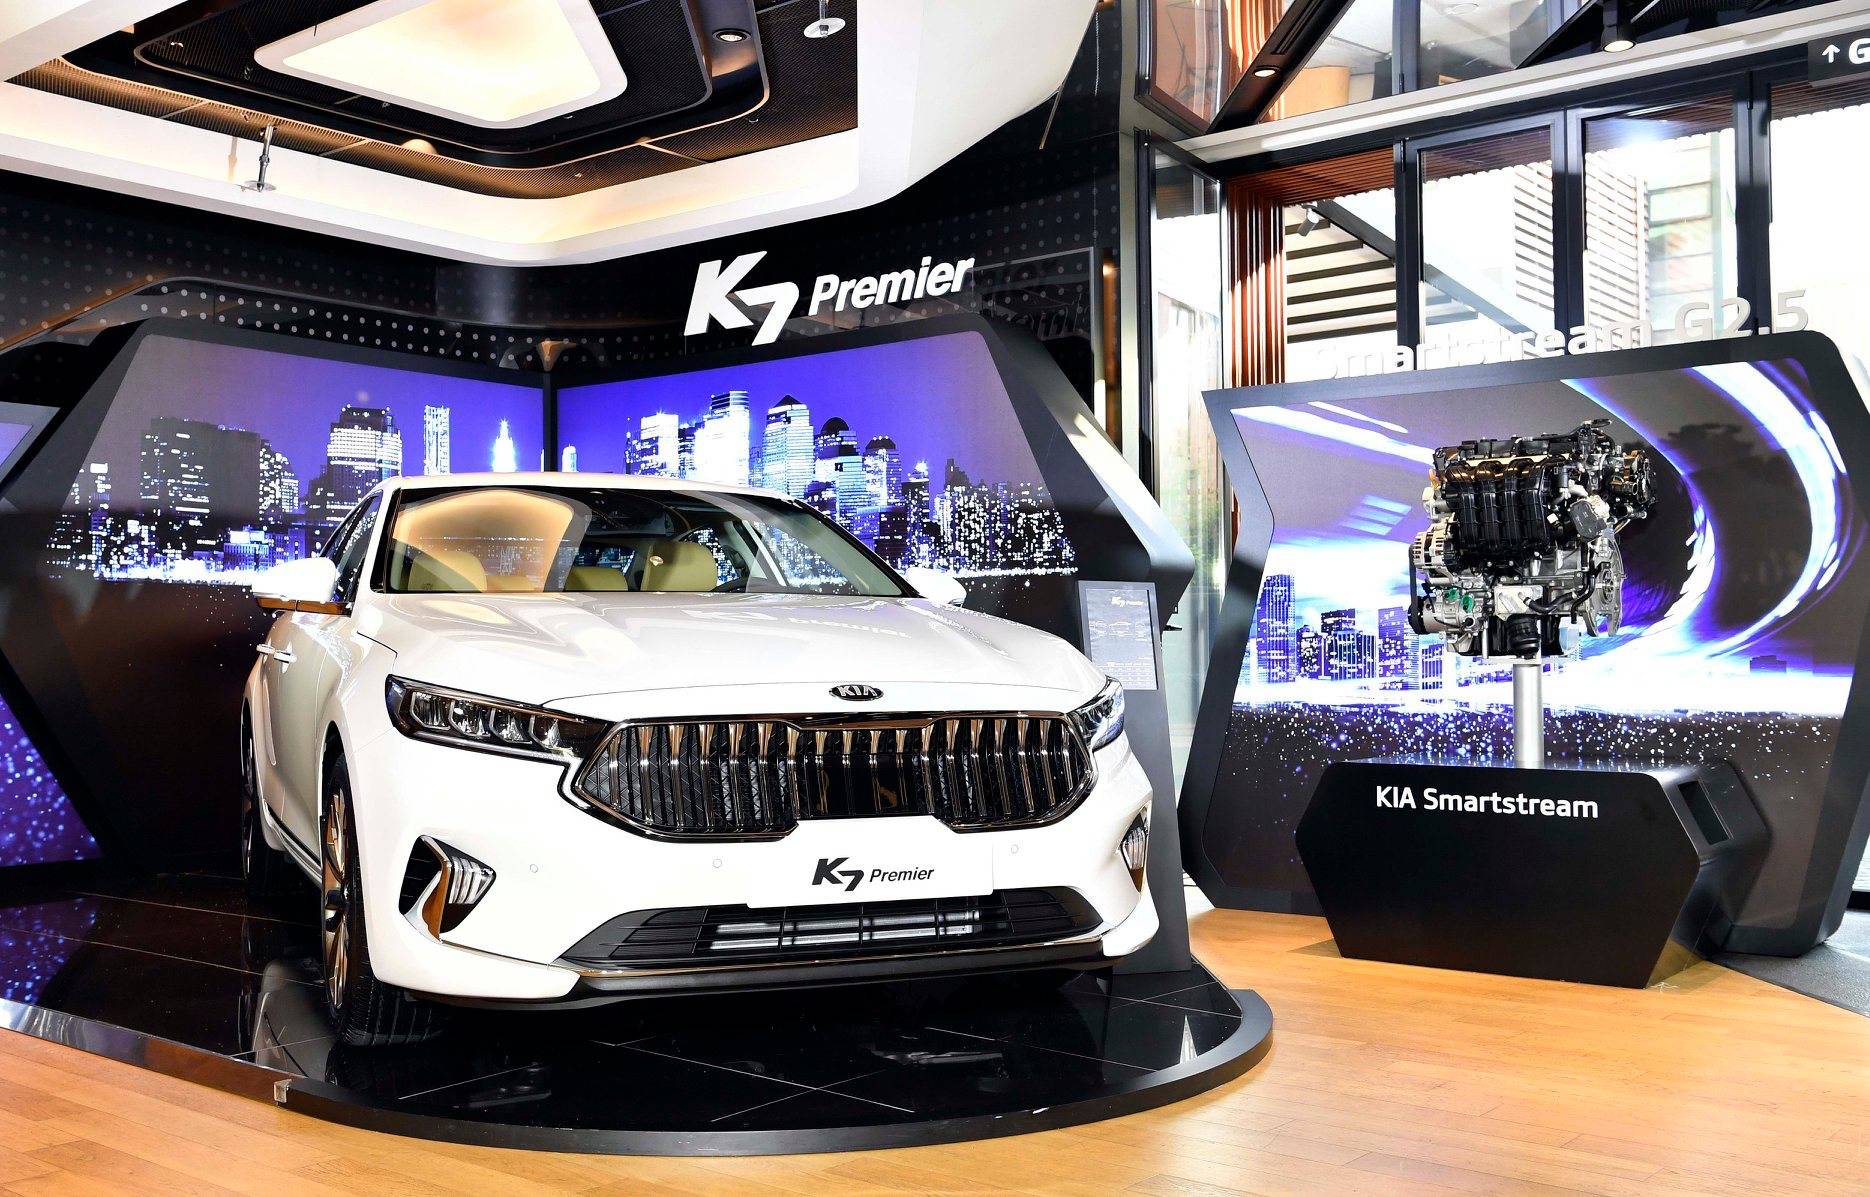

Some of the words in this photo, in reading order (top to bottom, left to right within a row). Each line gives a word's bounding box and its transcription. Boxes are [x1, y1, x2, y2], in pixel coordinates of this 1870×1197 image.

[684, 251, 799, 346] K7
[808, 256, 975, 316] Premier
[1675, 289, 1808, 340] G2.5
[1376, 785, 1417, 809] KIA
[1423, 787, 1598, 818] Smartstream
[812, 857, 864, 892] K7
[869, 867, 934, 883] Premier
